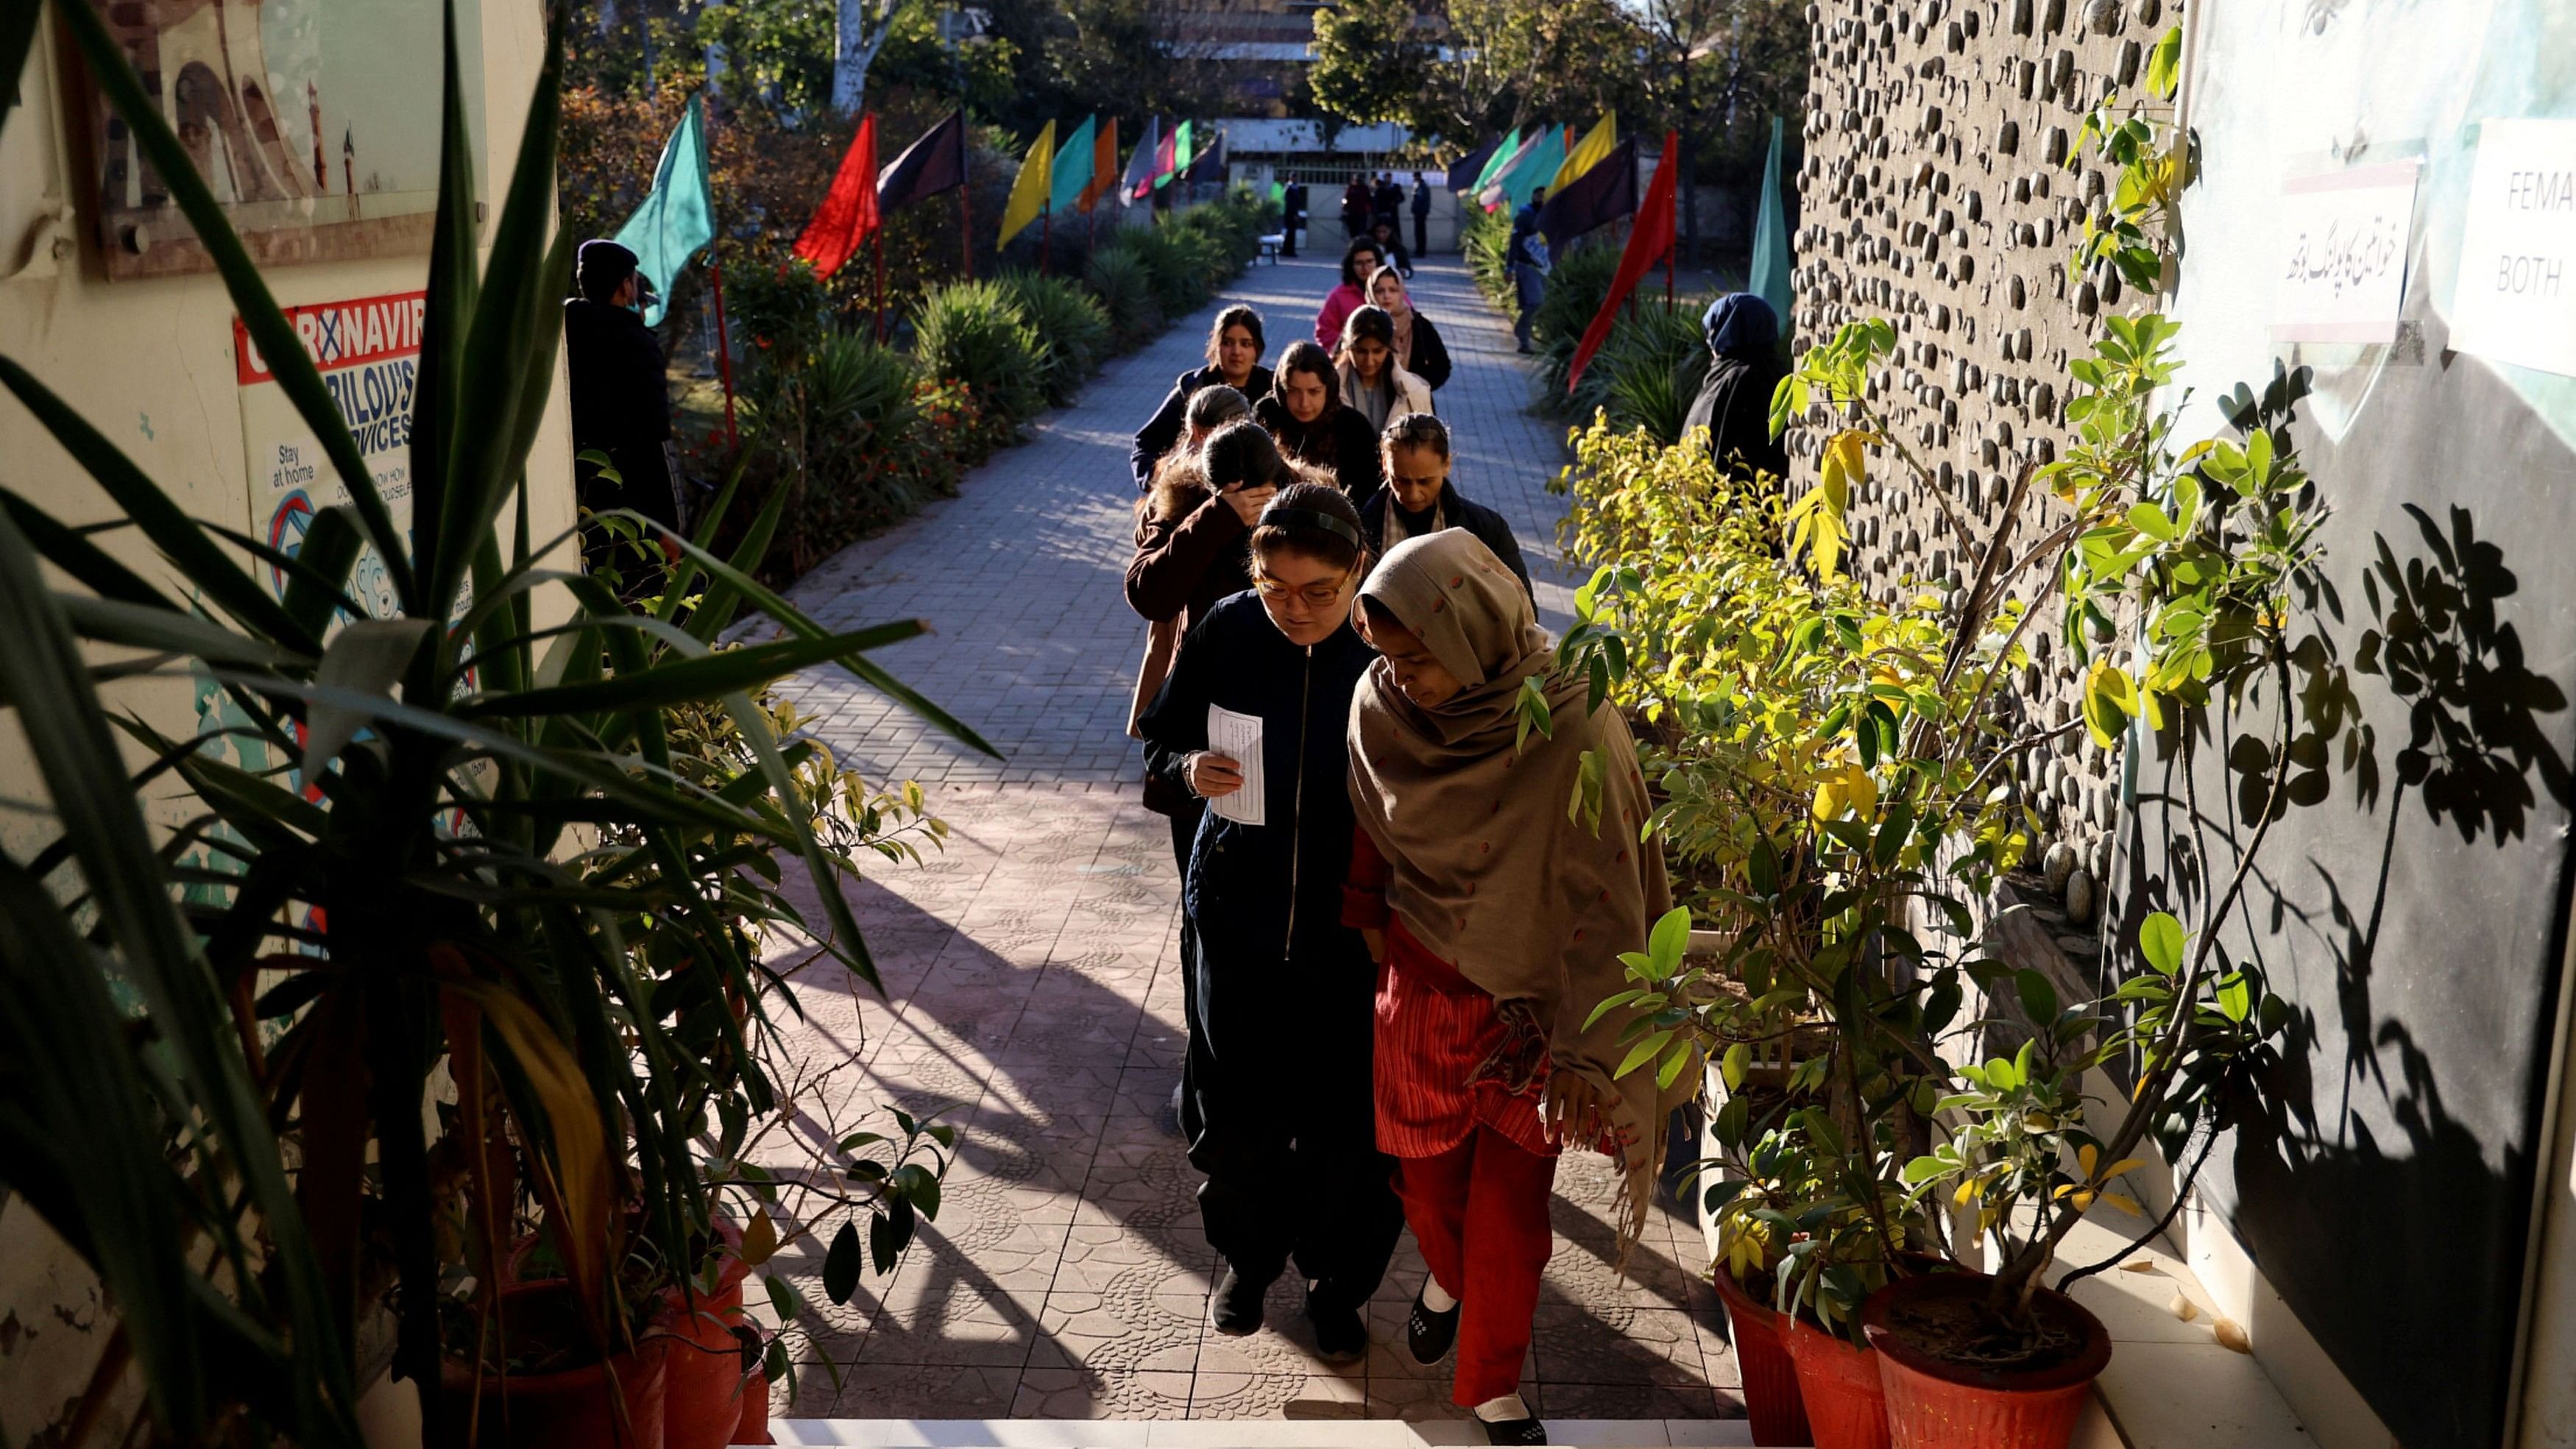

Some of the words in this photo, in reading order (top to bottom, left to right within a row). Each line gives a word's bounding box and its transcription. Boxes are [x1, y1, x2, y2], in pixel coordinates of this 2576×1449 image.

[2309, 217, 2343, 300] پولنگ
[2343, 227, 2362, 278] کا
[2352, 215, 2399, 286] خواتین
[2497, 255, 2563, 297] BOTH
[274, 468, 284, 488] at
[284, 465, 314, 485] home
[279, 444, 298, 466] Stay
